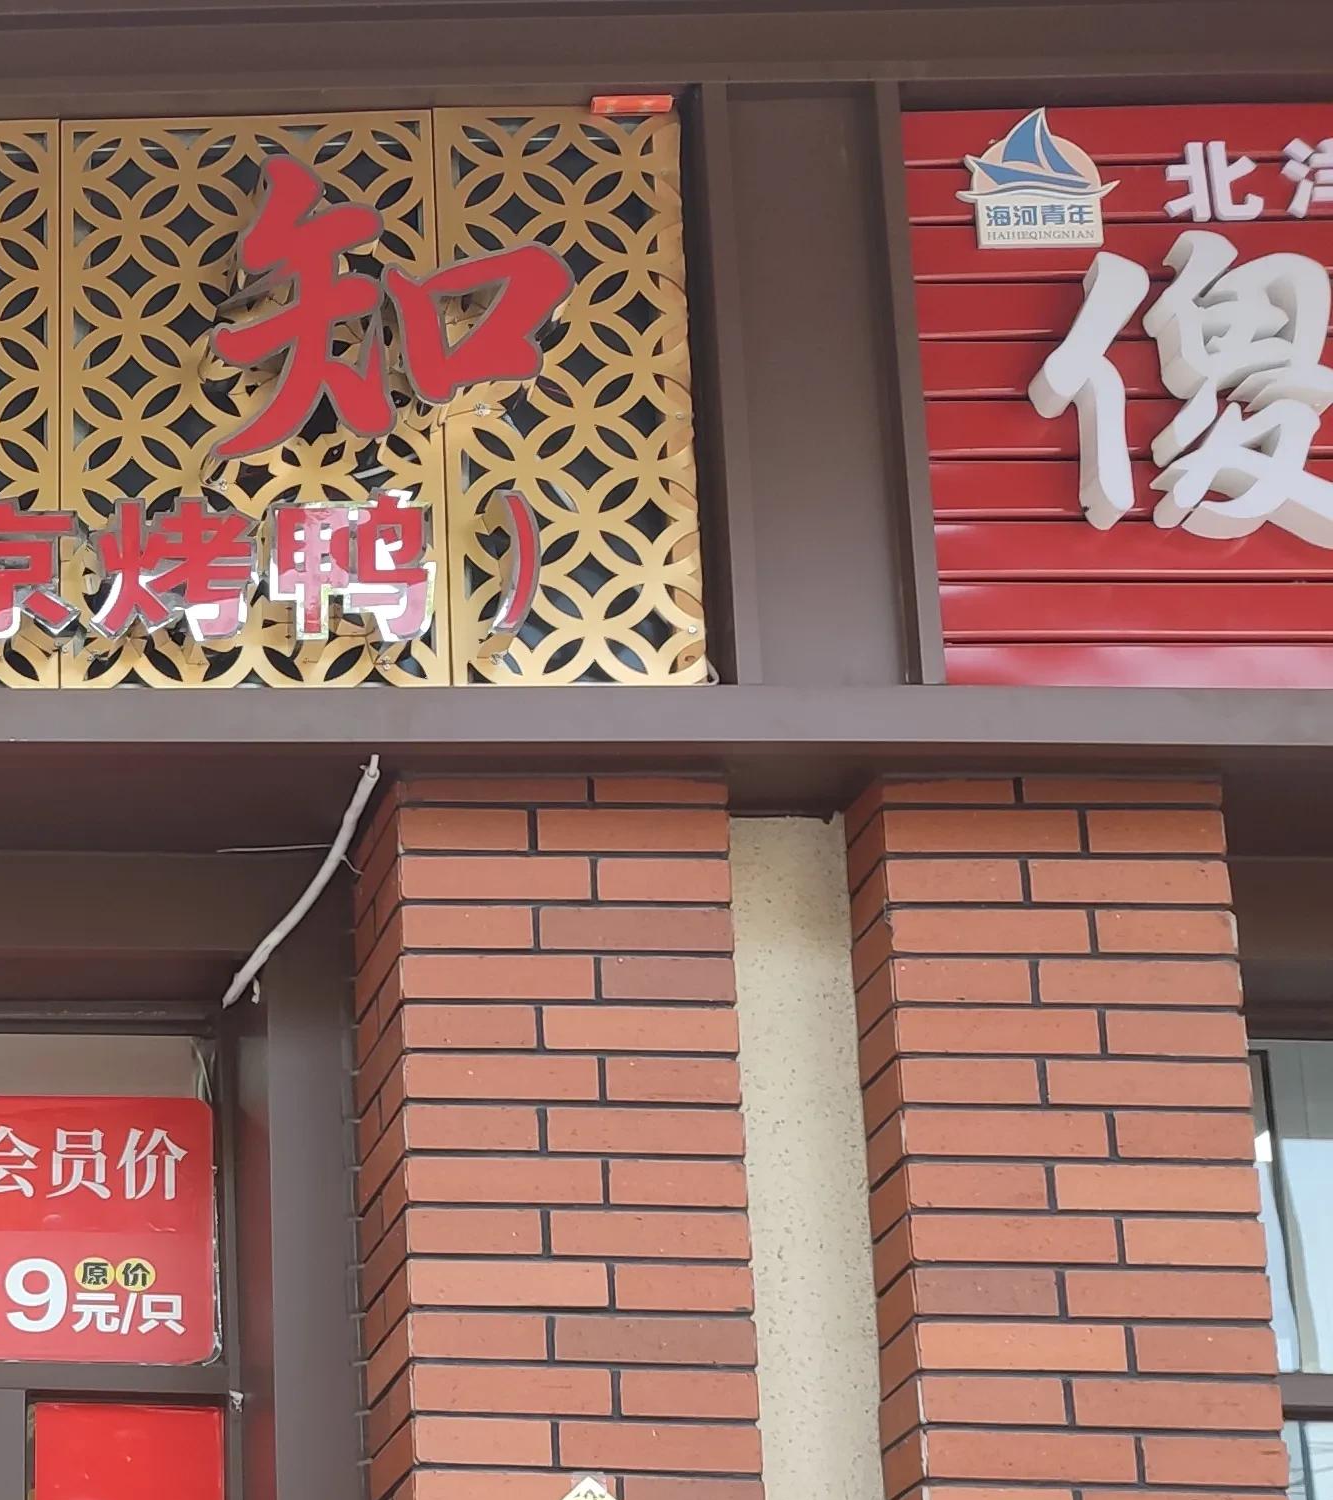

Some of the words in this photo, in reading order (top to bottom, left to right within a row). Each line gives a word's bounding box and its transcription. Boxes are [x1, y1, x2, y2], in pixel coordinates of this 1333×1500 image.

[985, 204, 1094, 227] 海河青年
[987, 230, 1095, 241] HAIHEQINGNIAN
[81, 1262, 156, 1288] 原价
